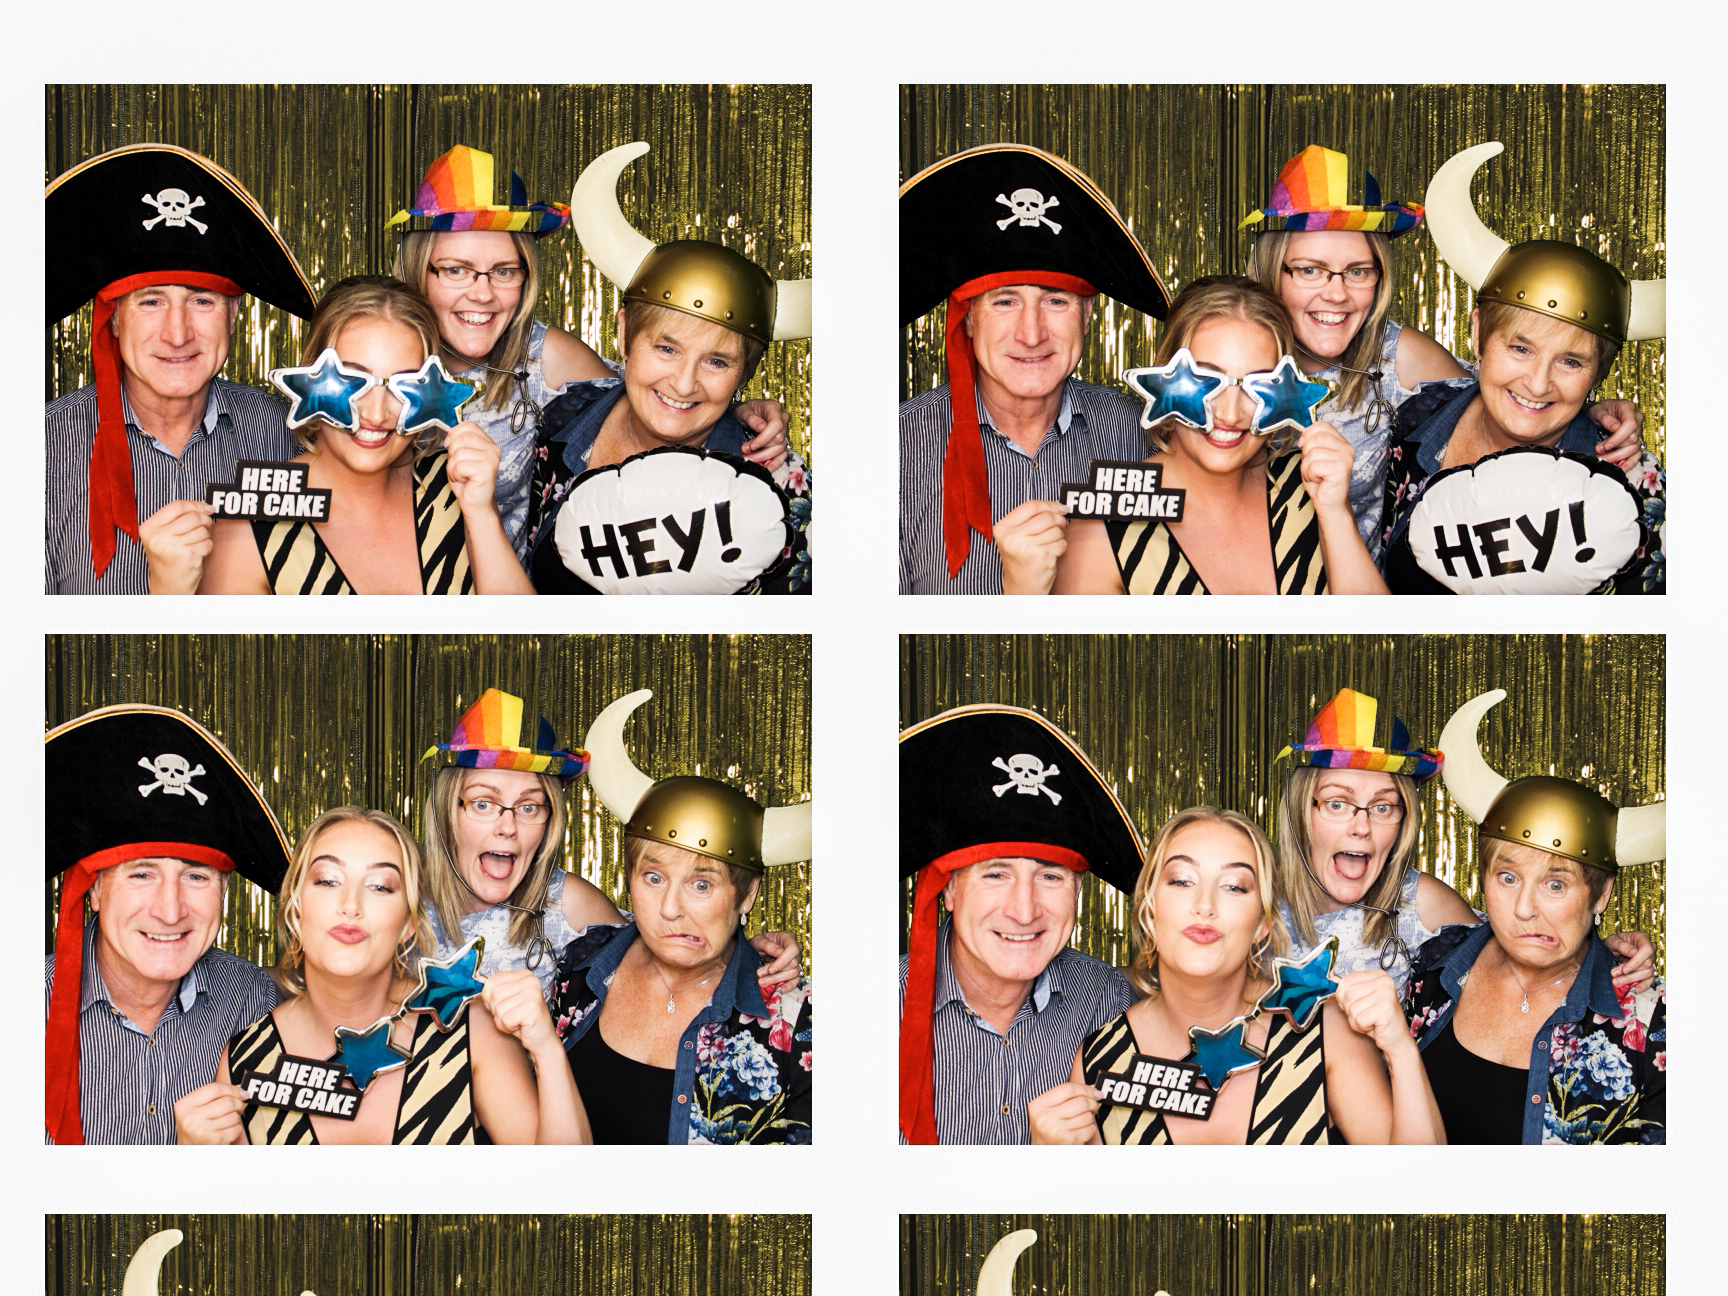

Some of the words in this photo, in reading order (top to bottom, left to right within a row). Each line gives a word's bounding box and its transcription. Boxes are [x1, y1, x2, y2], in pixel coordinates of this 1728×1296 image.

[241, 467, 303, 493] HERE
[1095, 467, 1157, 493] HERE
[212, 491, 259, 516] FOR
[263, 493, 326, 518] CAKE
[1066, 491, 1113, 516] FOR
[1117, 493, 1180, 518] CAKE
[579, 500, 742, 579] HEY!
[1433, 500, 1596, 579] HEY!
[278, 1061, 340, 1091] HERE
[1132, 1061, 1194, 1091] HERE
[247, 1078, 293, 1106] FOR
[294, 1087, 357, 1116] CAKE
[1101, 1078, 1147, 1106] FOR
[1148, 1087, 1211, 1116] CAKE
